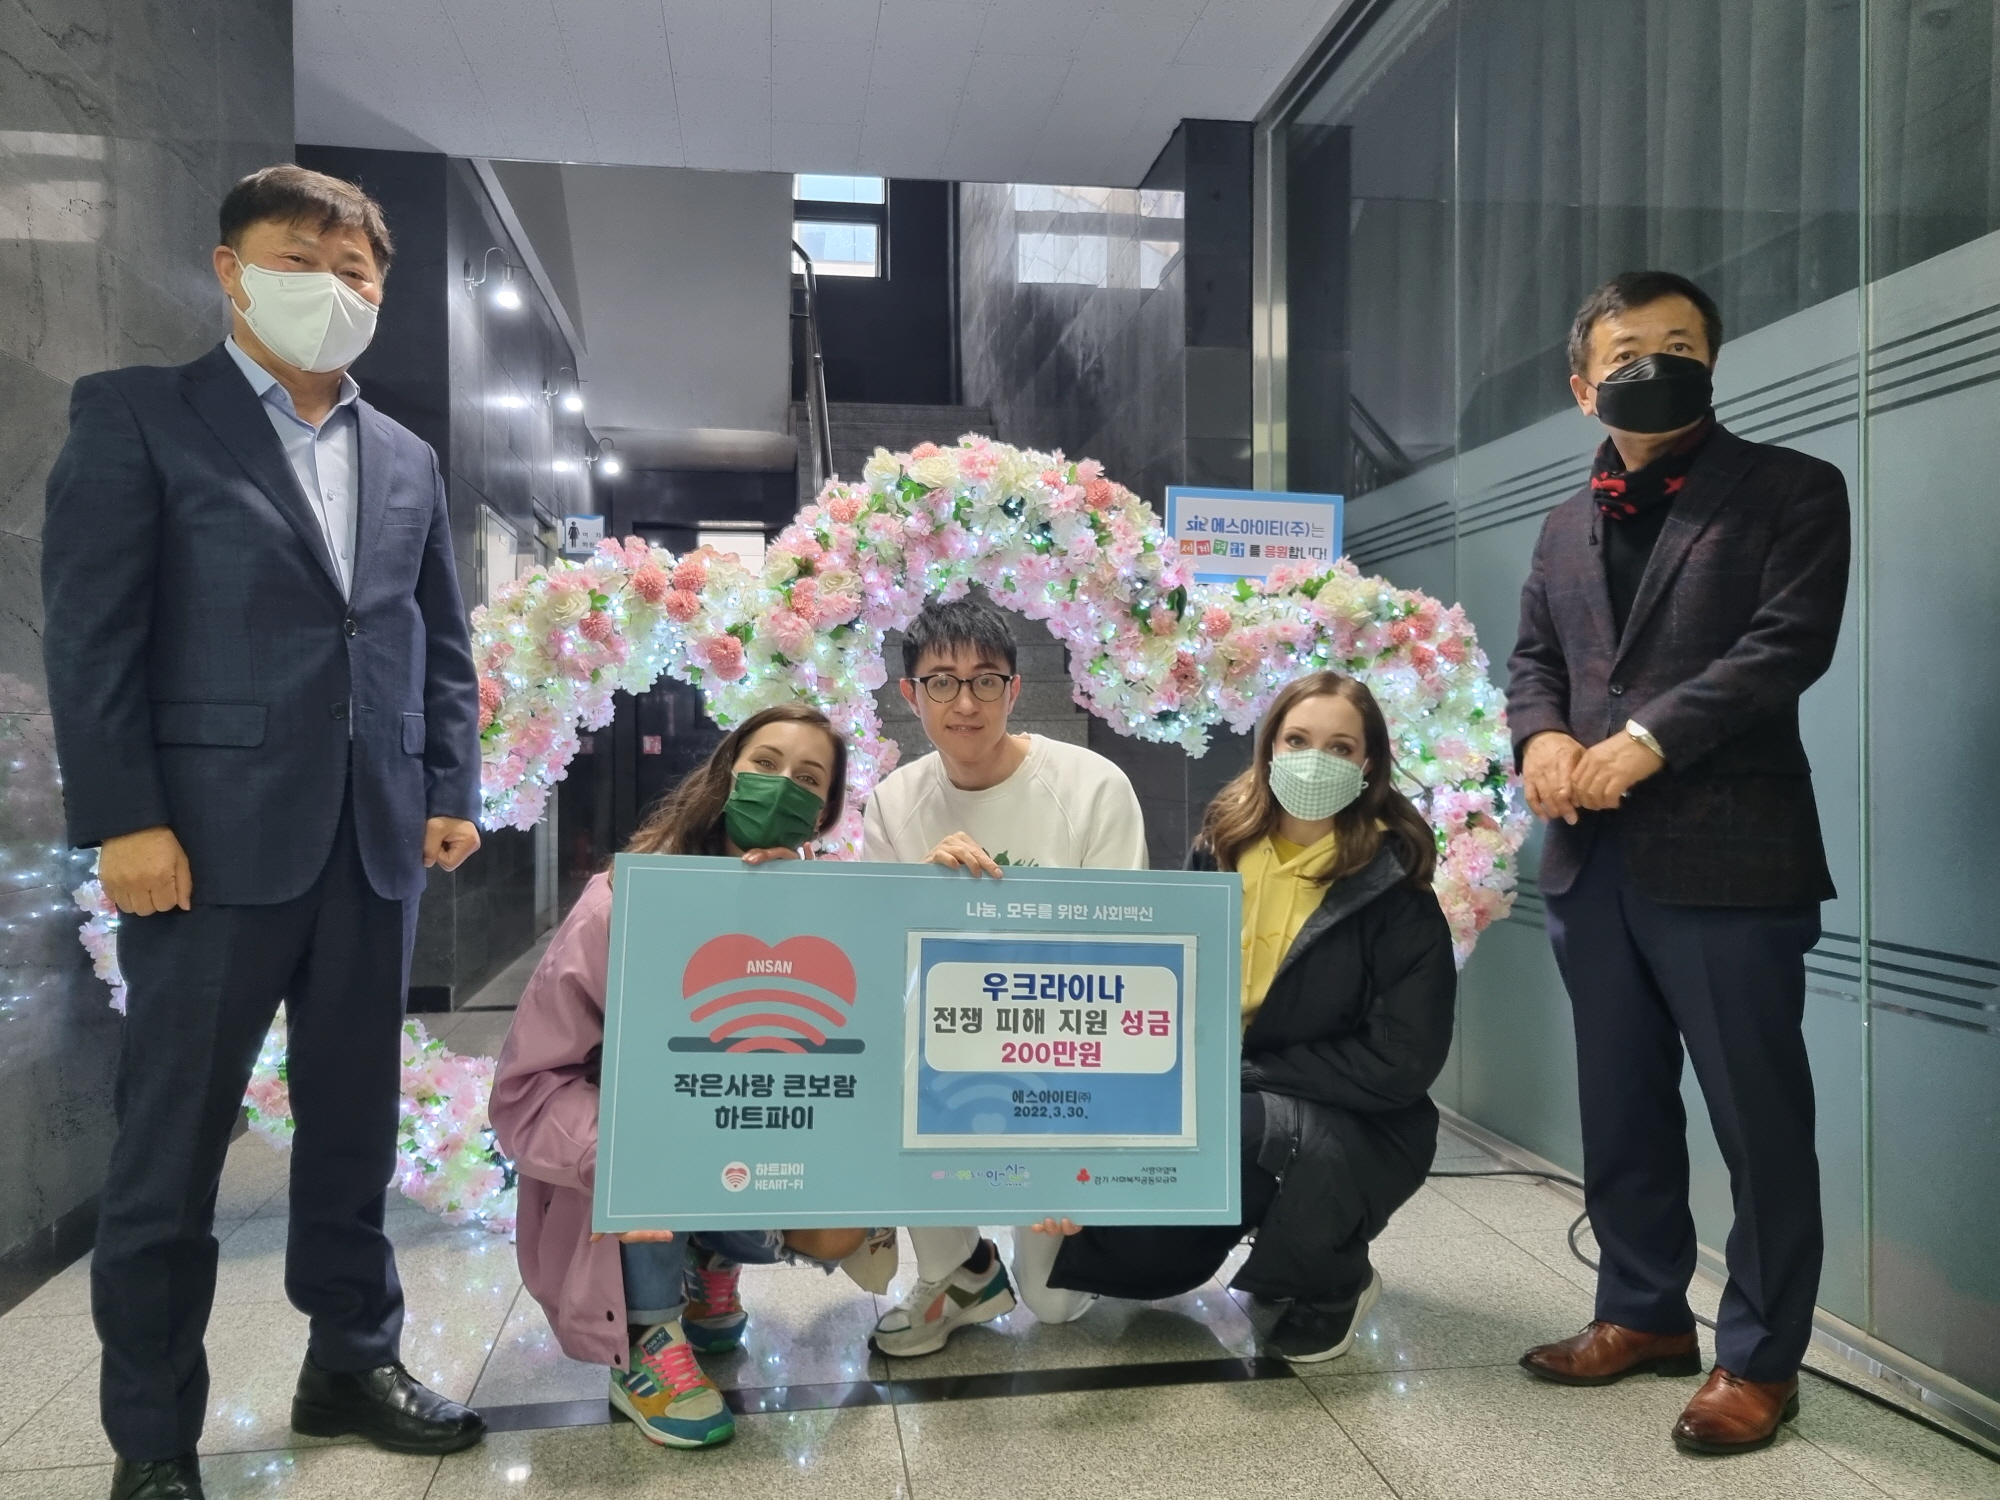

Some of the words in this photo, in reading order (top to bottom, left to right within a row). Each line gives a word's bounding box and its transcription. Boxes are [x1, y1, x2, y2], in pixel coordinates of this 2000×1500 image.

[1211, 517, 1325, 538] 에스아이티(주)는
[1264, 545, 1327, 560] 응원합니다!
[965, 902, 1001, 919] 나눔,
[1006, 903, 1052, 919] 모두를
[1058, 904, 1088, 920] 위한
[1093, 905, 1154, 922] 사회백신
[746, 959, 793, 974] ANSAN
[982, 972, 1125, 1003] 우크라이나
[933, 1006, 983, 1034] 전쟁
[996, 1007, 1045, 1035] 피해
[1058, 1008, 1108, 1036] 지원
[1120, 1009, 1171, 1037] 성금
[1001, 1041, 1102, 1068] 200만원
[673, 1072, 775, 1098] 작은사랑
[783, 1073, 857, 1099] 큰보람
[714, 1105, 814, 1130] 하트파이
[1013, 1106, 1089, 1119] 2022.3.30.
[755, 1163, 805, 1176] 하트파이
[754, 1179, 804, 1191] HEART-FI
